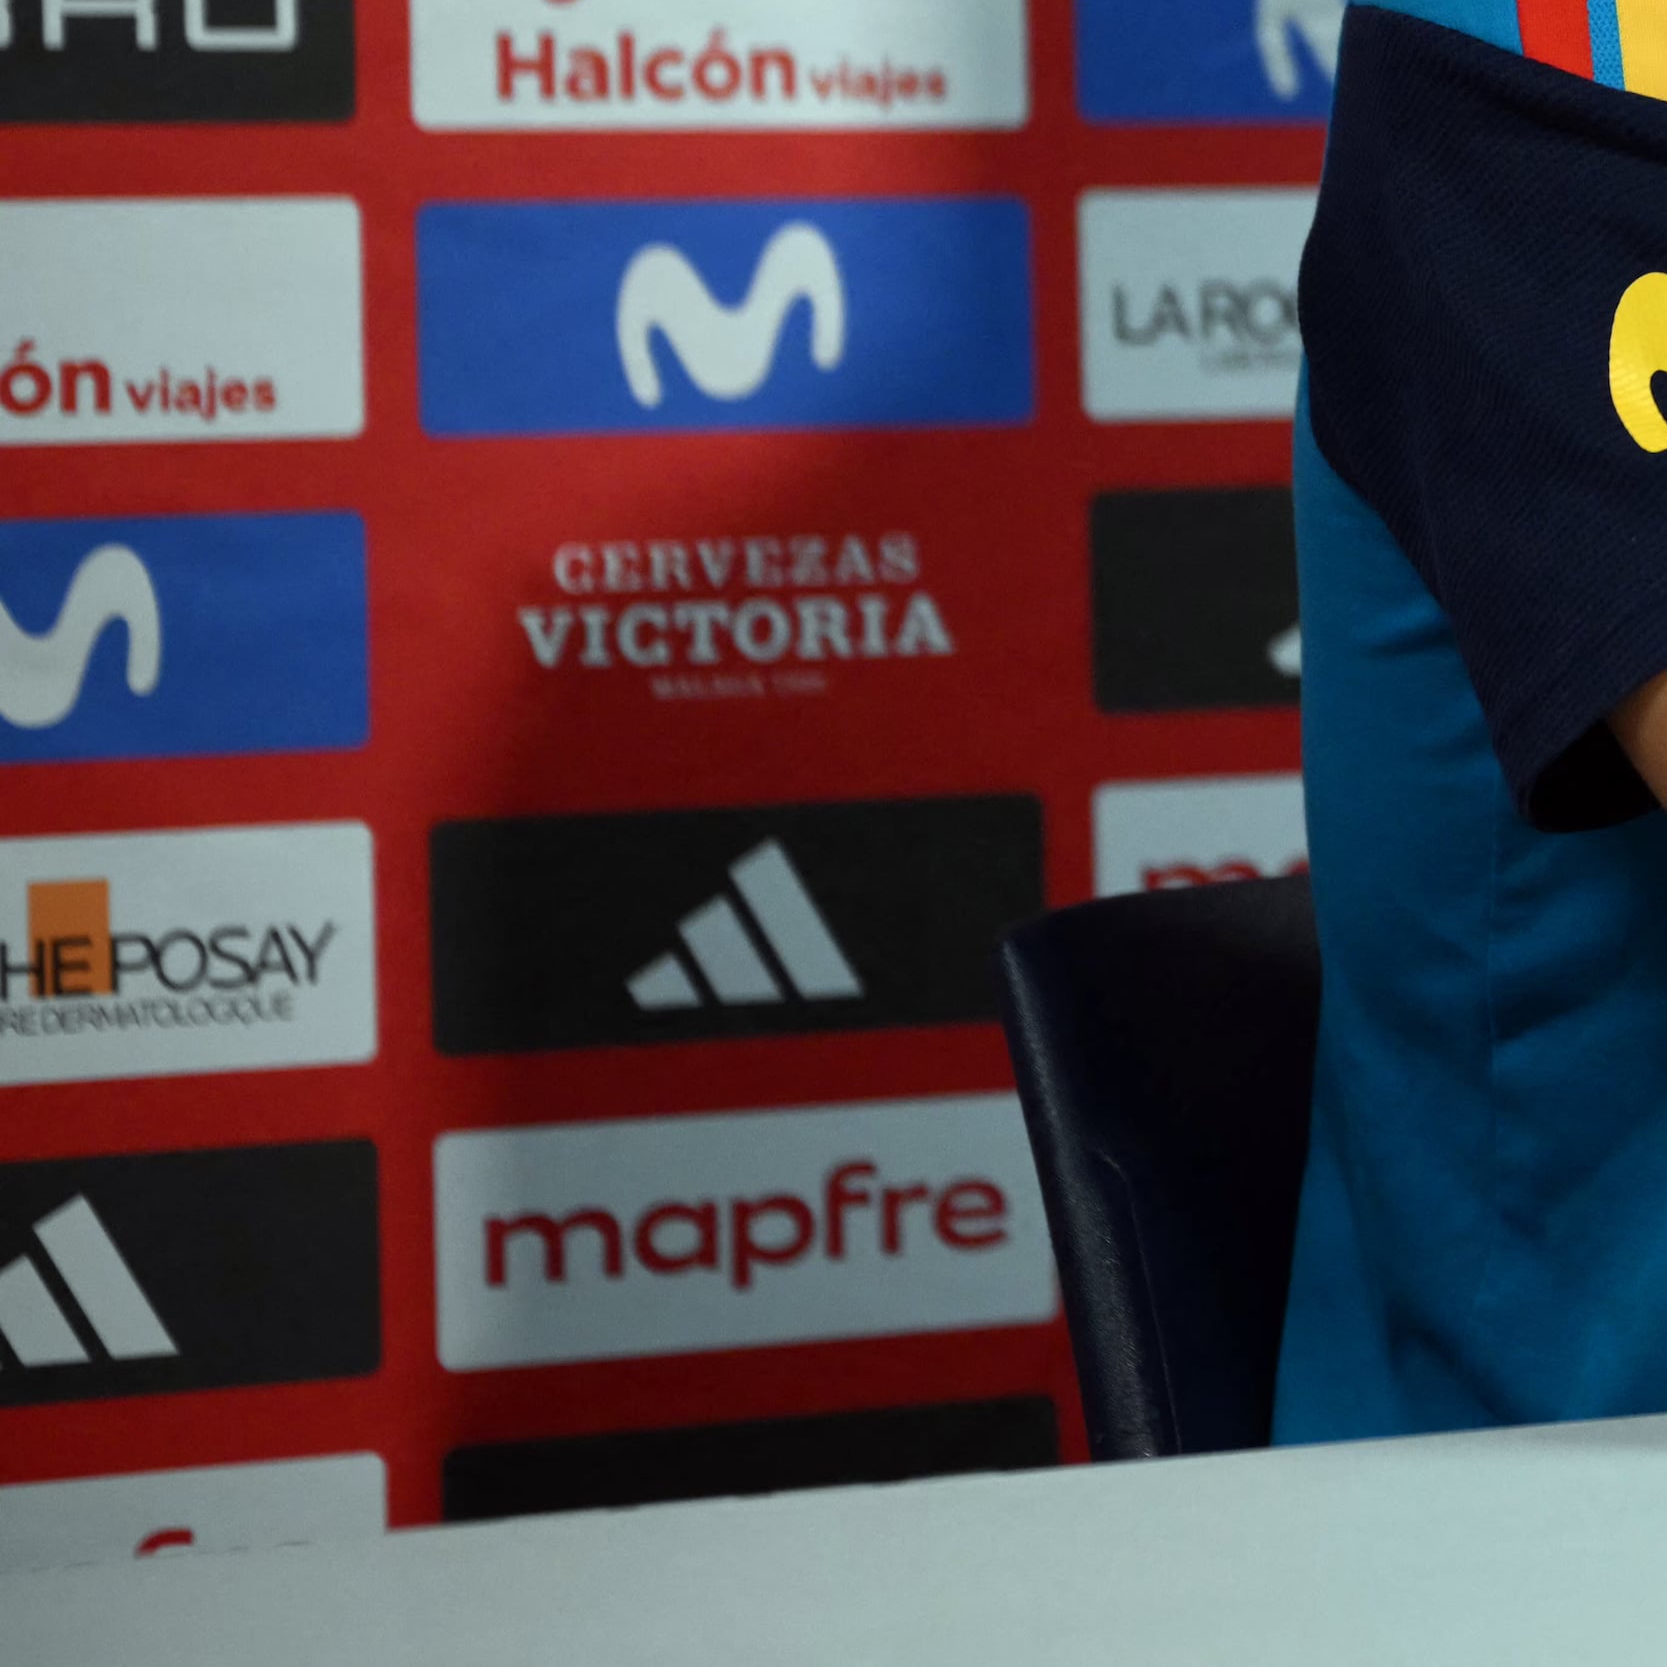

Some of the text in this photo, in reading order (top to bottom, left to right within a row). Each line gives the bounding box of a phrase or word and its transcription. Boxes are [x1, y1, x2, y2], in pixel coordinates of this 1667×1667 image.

[497, 33, 948, 112] Halcón viajes
[124, 368, 277, 421] viajes
[551, 532, 919, 594] CERVEZAS
[518, 590, 954, 669] VICTORIA
[108, 921, 338, 995] POSAY
[485, 1161, 1006, 1290] mapfre
